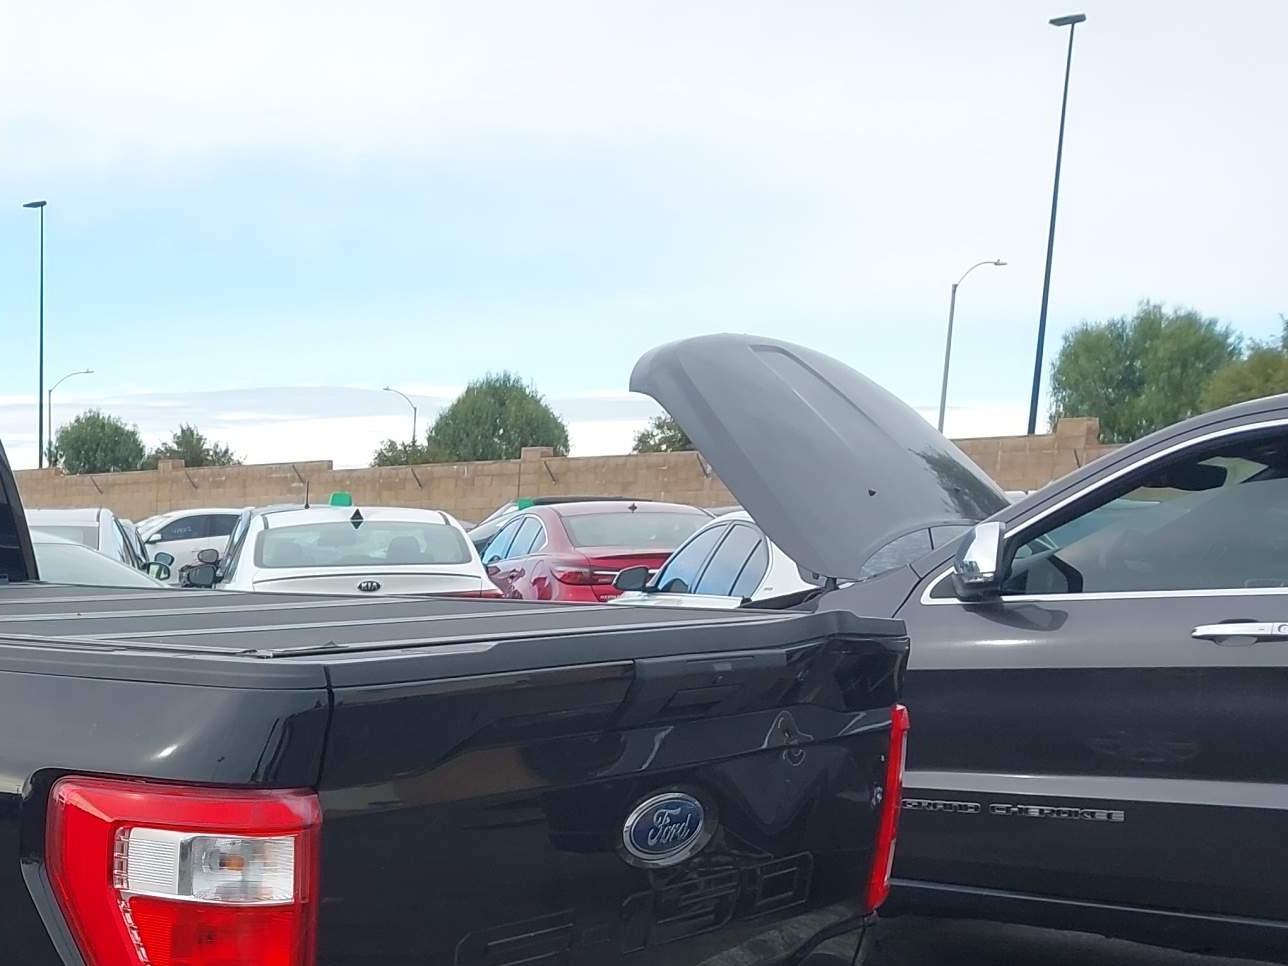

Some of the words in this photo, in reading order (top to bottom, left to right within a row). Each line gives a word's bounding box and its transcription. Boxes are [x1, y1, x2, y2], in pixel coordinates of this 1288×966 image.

[647, 807, 692, 846] Ford
[901, 798, 981, 814] GRAND
[988, 803, 1126, 823] CHEROKEE
